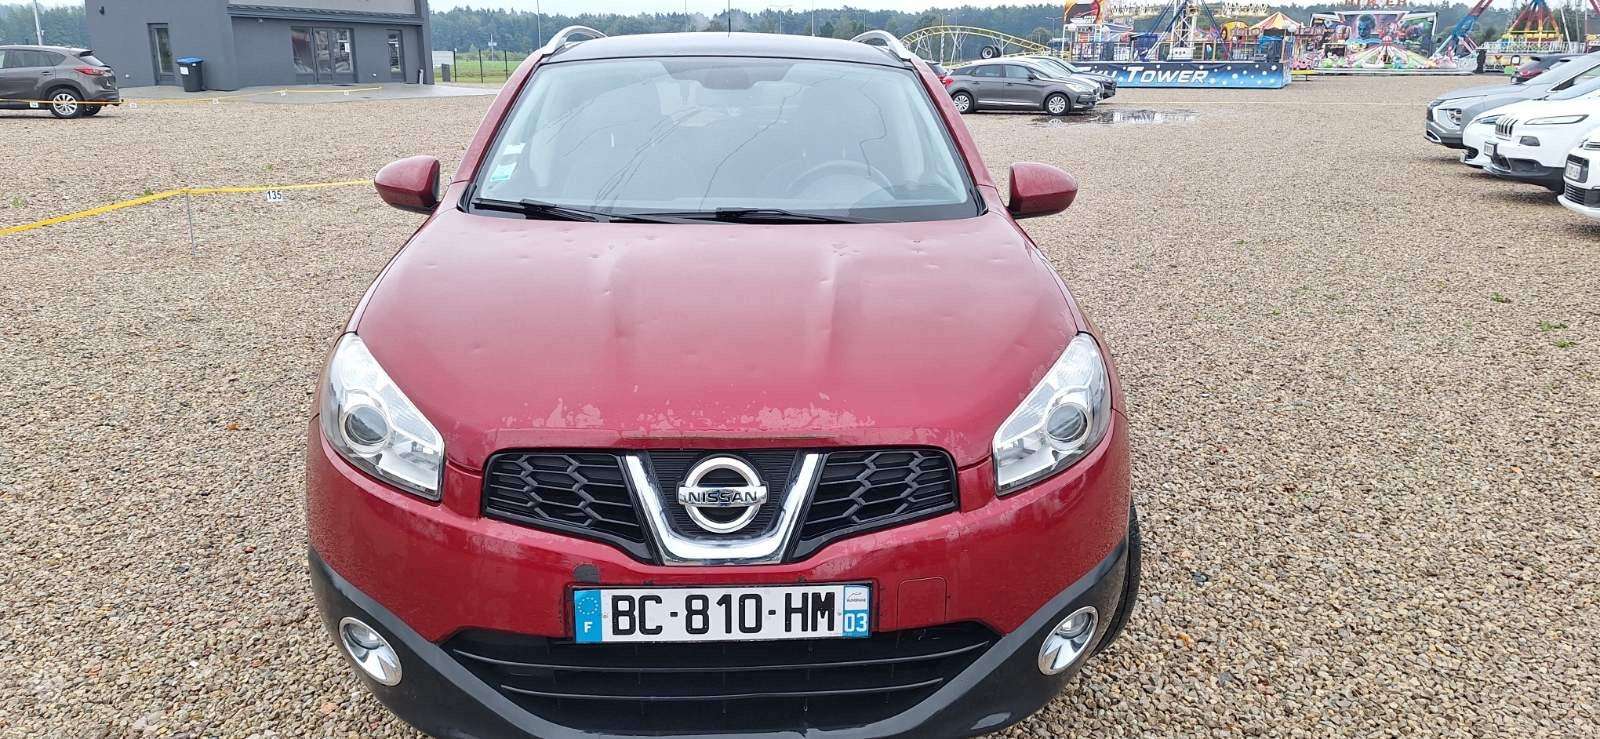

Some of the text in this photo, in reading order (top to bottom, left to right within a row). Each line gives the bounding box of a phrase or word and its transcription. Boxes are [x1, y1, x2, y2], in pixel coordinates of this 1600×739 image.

[1126, 66, 1209, 83] TOWER
[266, 190, 283, 200] 135
[688, 491, 757, 503] NISSAN
[583, 621, 593, 633] F
[844, 612, 868, 633] 03
